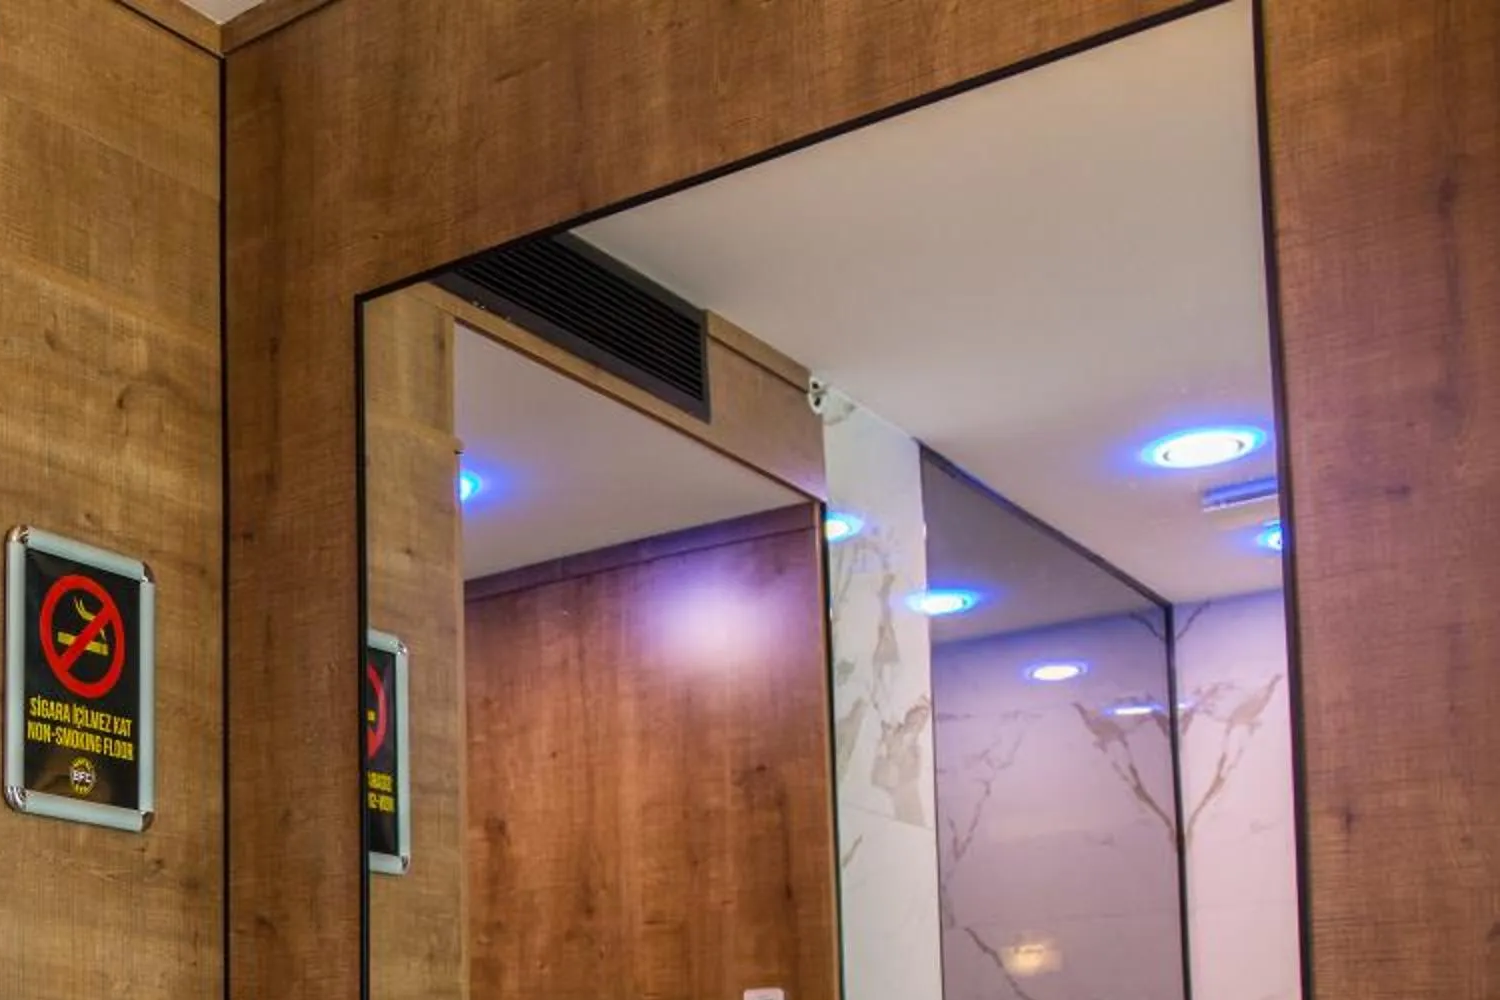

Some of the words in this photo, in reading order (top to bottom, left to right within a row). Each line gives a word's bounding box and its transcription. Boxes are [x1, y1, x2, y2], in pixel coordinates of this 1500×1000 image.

[29, 694, 70, 722] SİGARA
[73, 703, 111, 732] İÇİLMEZ
[113, 716, 133, 737] KAT
[28, 721, 102, 753] NON-SMOKING
[103, 738, 134, 760] FLOOR
